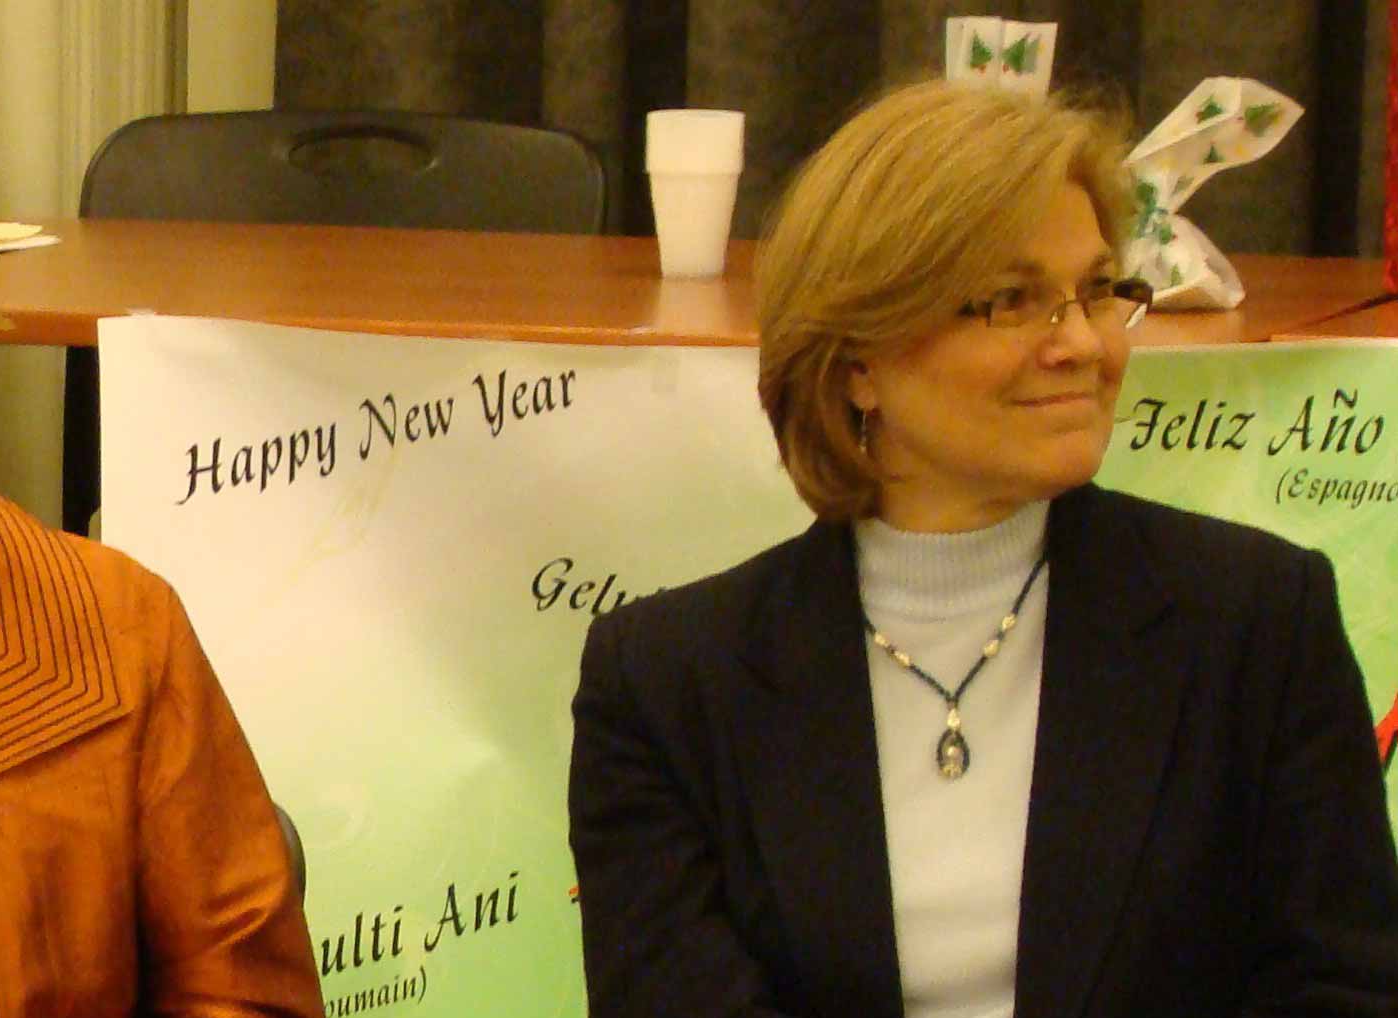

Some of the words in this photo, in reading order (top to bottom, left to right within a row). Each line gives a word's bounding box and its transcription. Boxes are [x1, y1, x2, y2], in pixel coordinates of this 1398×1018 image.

[175, 422, 337, 506] Happy
[359, 393, 454, 461] New
[472, 368, 576, 437] Year
[1129, 397, 1257, 452] Feliz
[1267, 388, 1385, 456] Año
[1275, 467, 1398, 509] (Espagno
[321, 905, 403, 977] ulti
[424, 870, 520, 952] Ani
